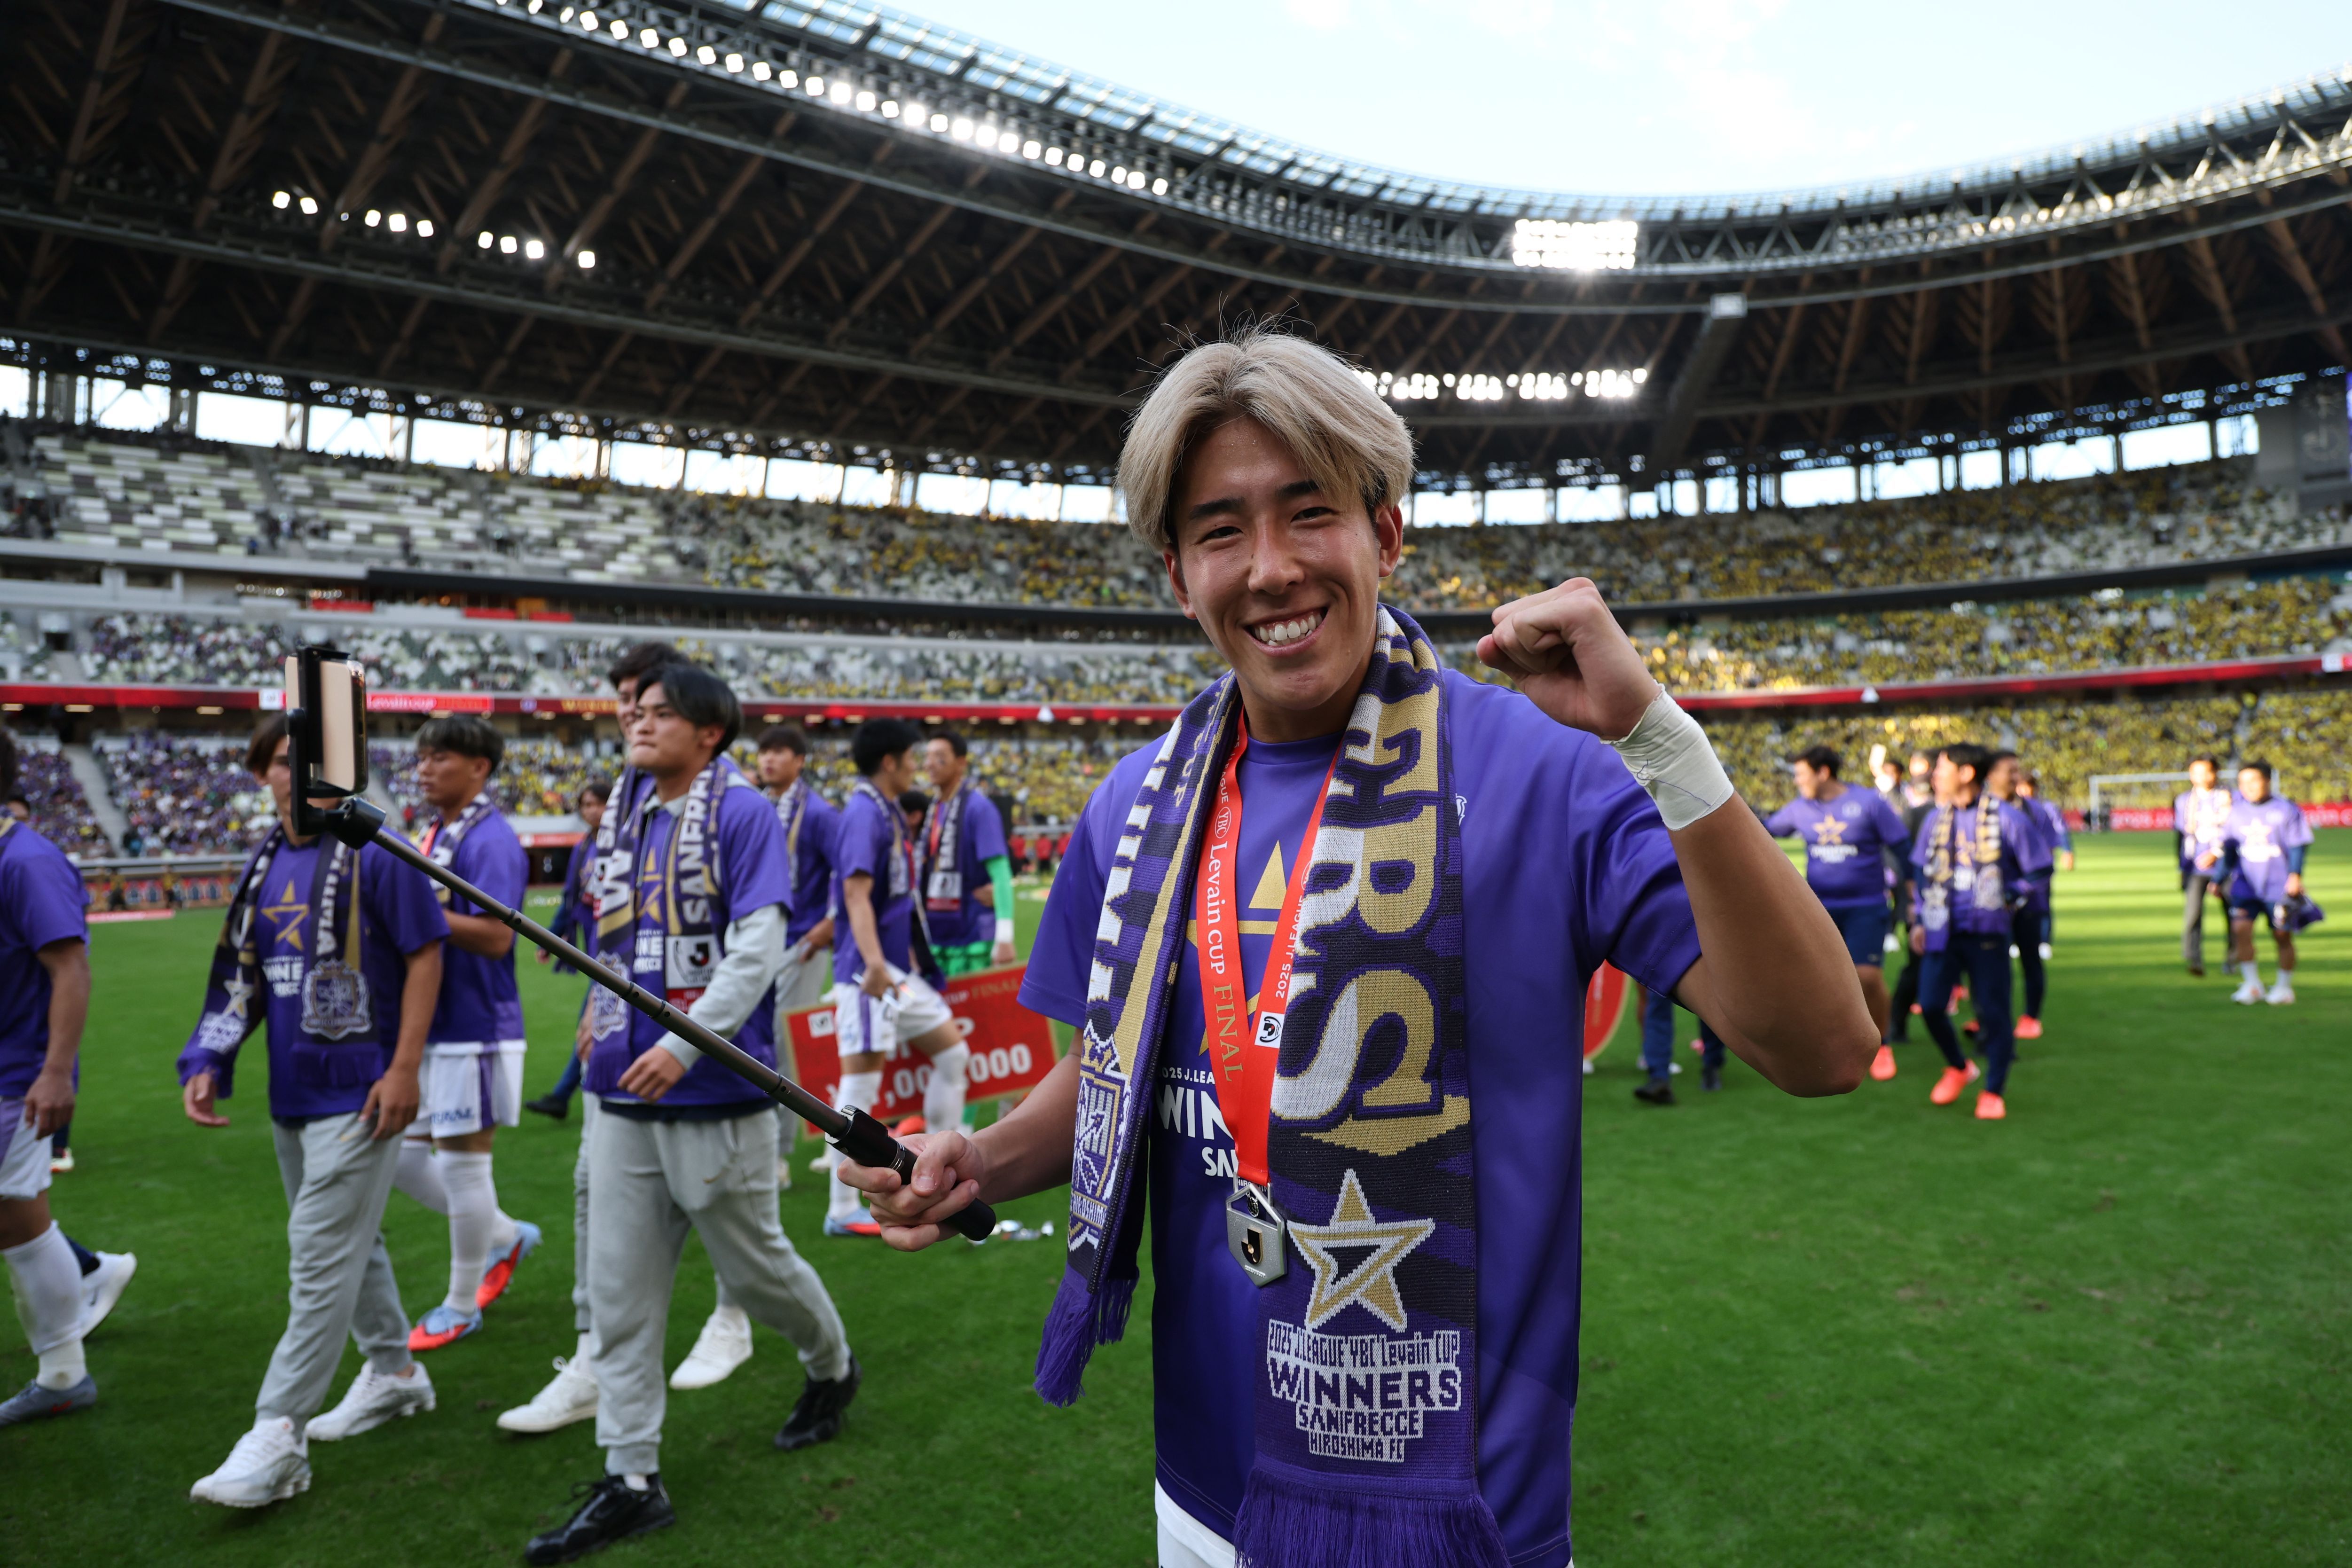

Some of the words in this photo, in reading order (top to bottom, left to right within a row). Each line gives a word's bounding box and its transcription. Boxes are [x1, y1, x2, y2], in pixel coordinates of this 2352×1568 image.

[1215, 809, 1230, 836] YBC
[1207, 841, 1227, 925] Levain
[1207, 930, 1225, 974] CUP
[1275, 963, 1291, 999] 2025
[1213, 984, 1243, 1082] FINAL
[1161, 1067, 1182, 1079] 025
[1268, 1322, 1293, 1357] 2025
[1349, 1337, 1377, 1367] YBC
[1379, 1334, 1430, 1367] Levain
[1435, 1332, 1459, 1363] CUP
[1269, 1357, 1460, 1410] WINNERS
[1298, 1404, 1422, 1437] SANFRECCE
[1310, 1434, 1384, 1458] HIROSHIMA
